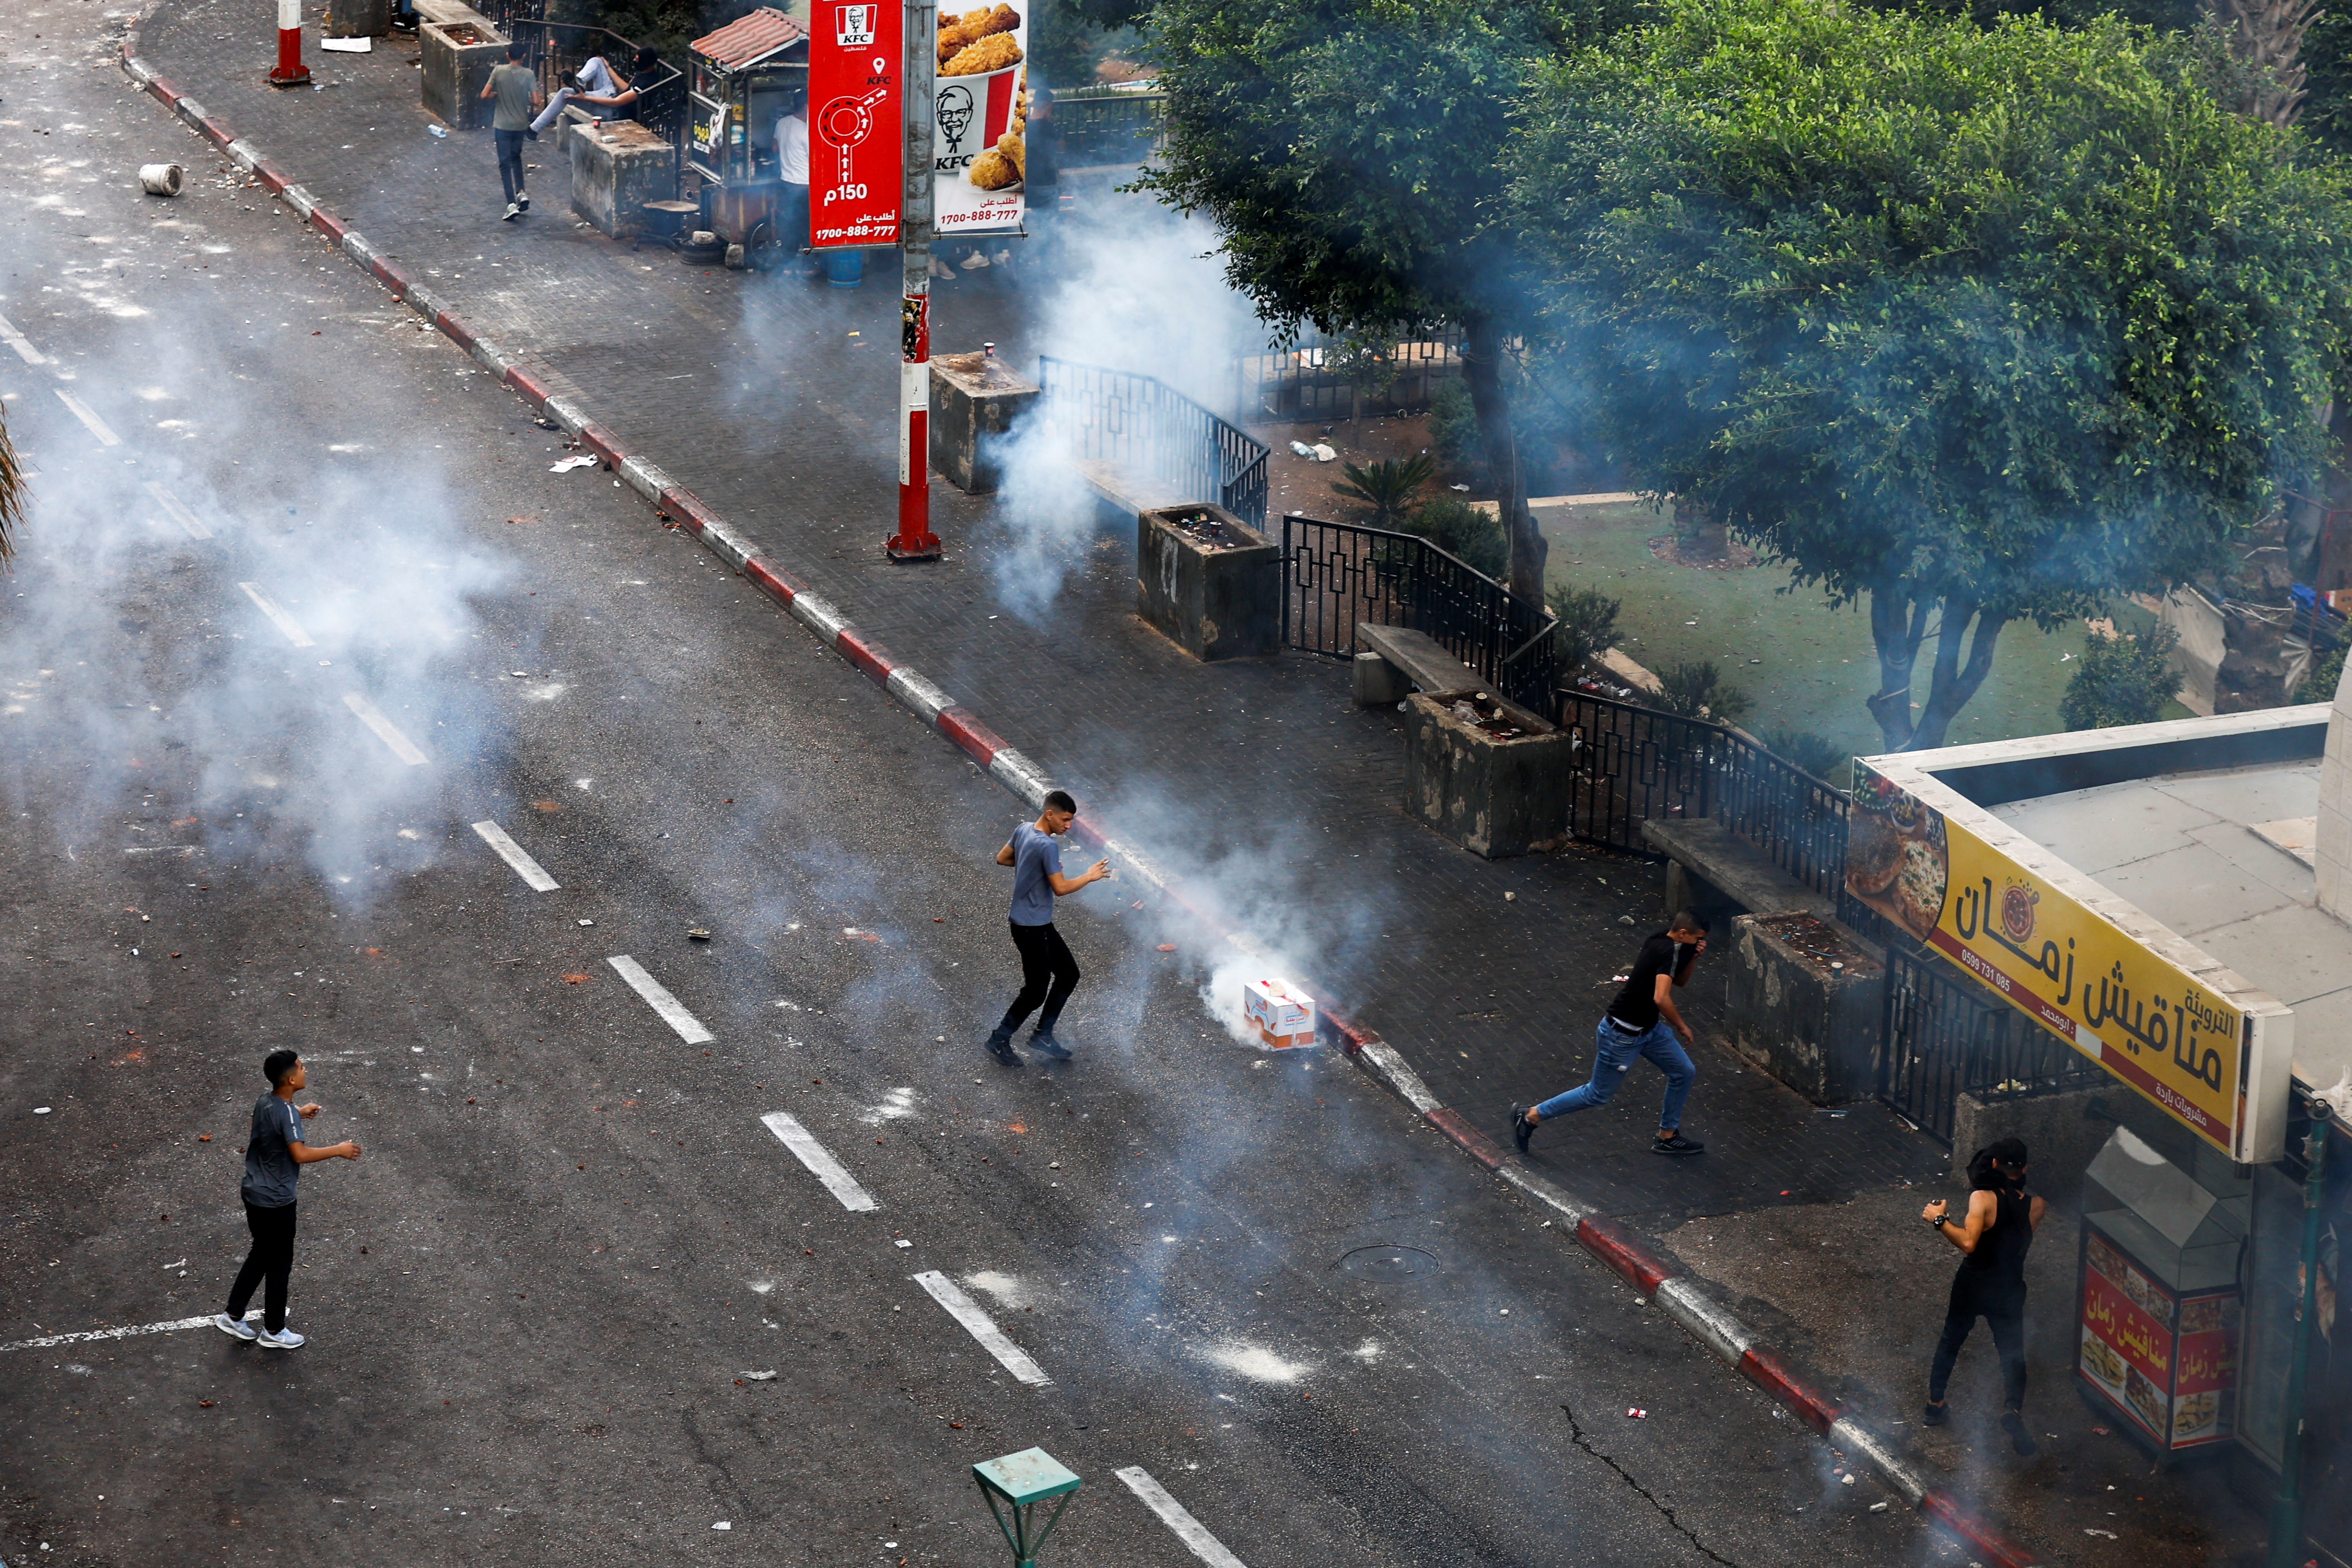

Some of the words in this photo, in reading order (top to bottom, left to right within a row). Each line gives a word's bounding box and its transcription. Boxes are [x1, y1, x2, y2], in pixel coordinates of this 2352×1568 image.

[843, 34, 868, 43] KFC
[866, 76, 891, 85] KFC
[935, 154, 974, 170] KFC
[980, 199, 995, 208] على
[997, 194, 1018, 207] أطلب
[856, 214, 872, 223] على
[873, 209, 895, 223] أطلب
[941, 210, 1017, 224] 1700-888-777
[816, 225, 896, 240] 1700-888-777
[1956, 877, 2075, 1005] زمان
[1962, 949, 1980, 970] 0599
[1981, 963, 1994, 980] 731
[1996, 974, 2010, 992] 085
[2083, 960, 2222, 1093] مناقيش
[2156, 1083, 2174, 1106] باردة
[2175, 1096, 2207, 1127] مشروبات
[2087, 1290, 2115, 1335] زمان
[2118, 1313, 2167, 1372] مناقيش
[2179, 1349, 2208, 1383] زمان
